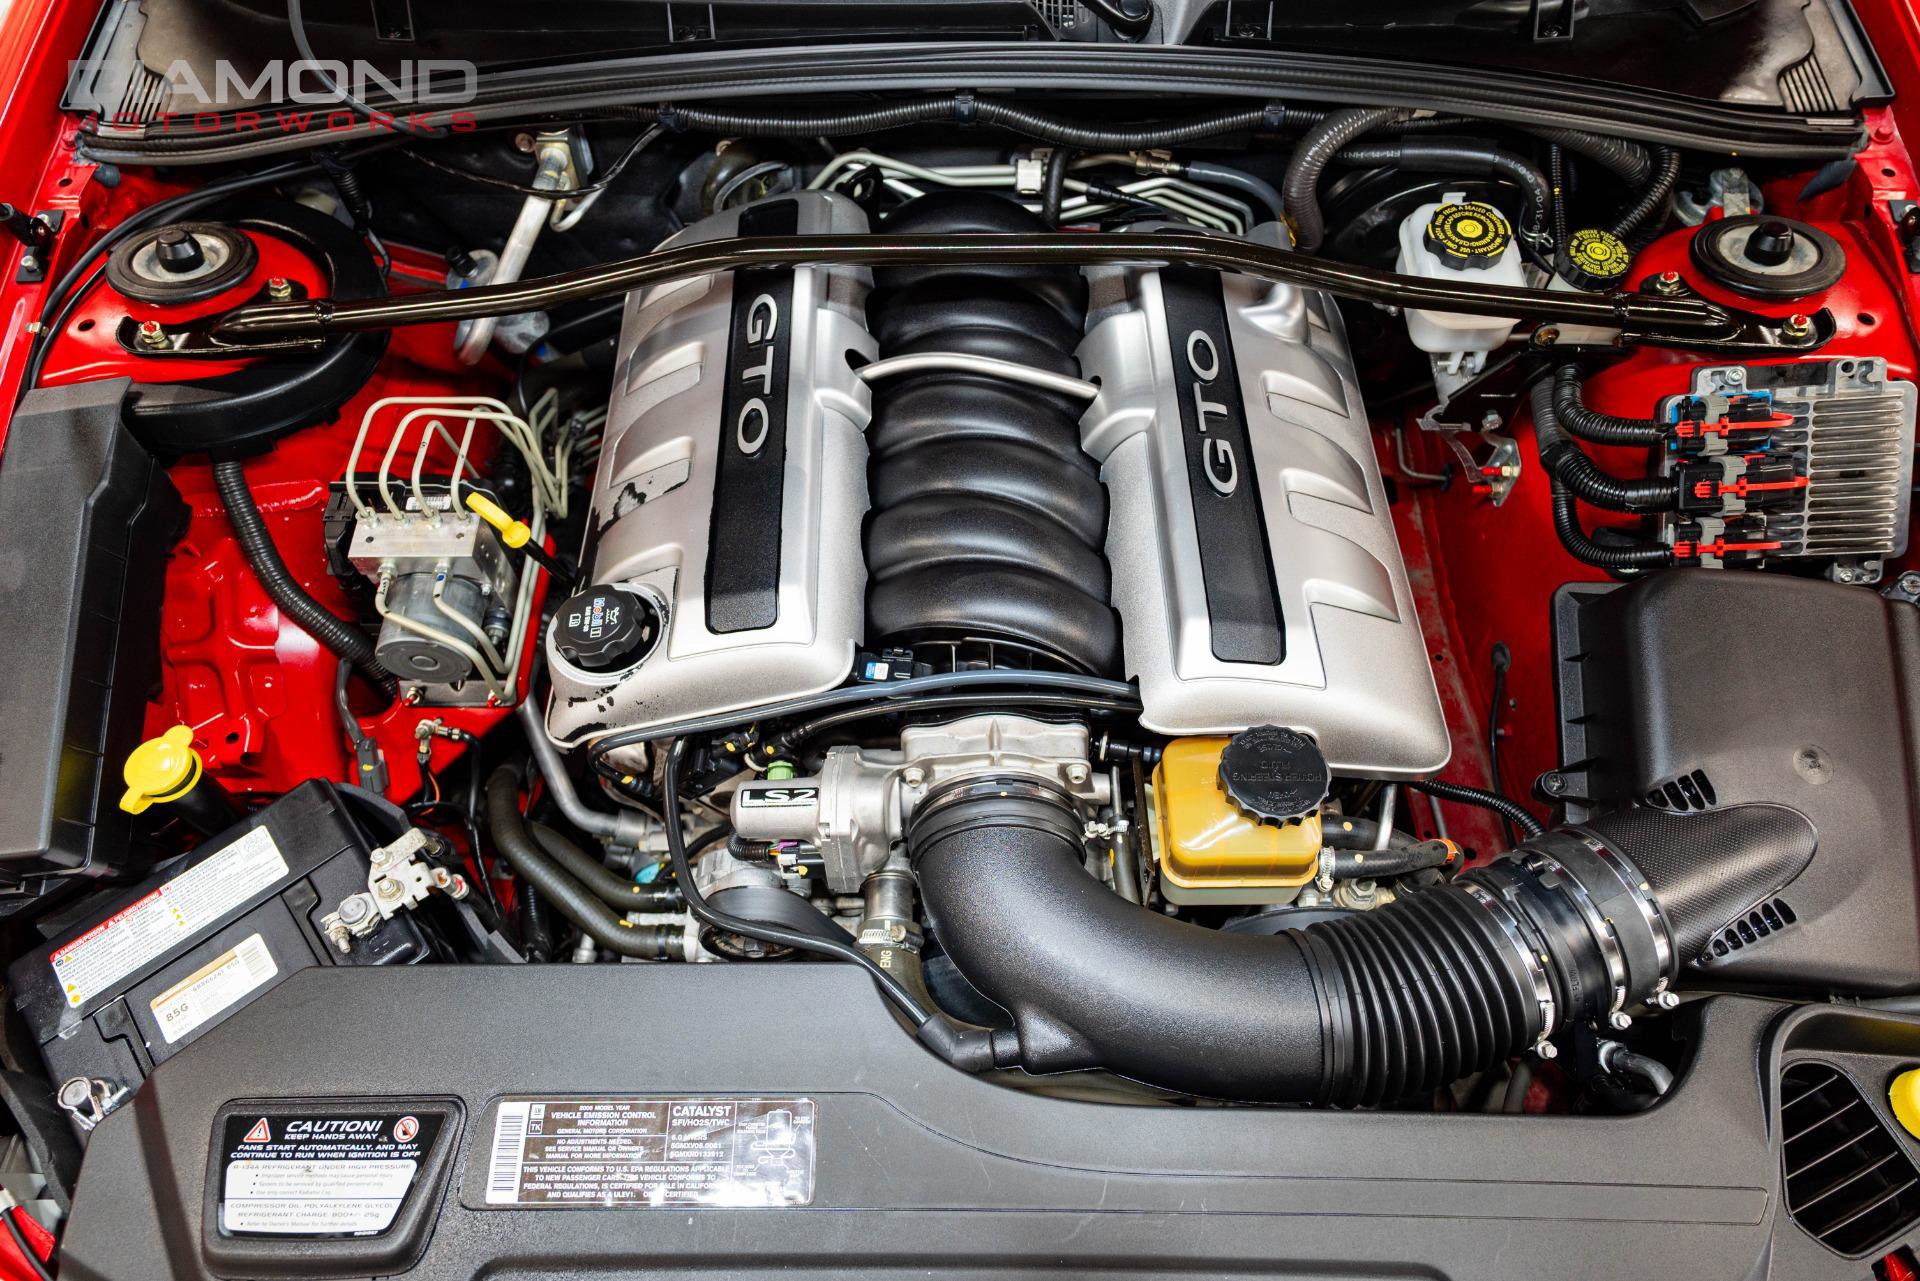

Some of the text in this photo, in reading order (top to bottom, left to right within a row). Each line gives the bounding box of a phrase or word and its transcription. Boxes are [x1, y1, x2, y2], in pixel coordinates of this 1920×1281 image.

[1464, 205, 1486, 213] SEALED
[737, 294, 778, 454] GTO
[1187, 329, 1238, 494] GTO
[742, 788, 817, 807] LS2
[880, 950, 892, 968] ENG
[166, 1002, 189, 1022] 85G
[673, 1106, 731, 1116] CATALYST
[286, 1121, 383, 1132] CAUTION!
